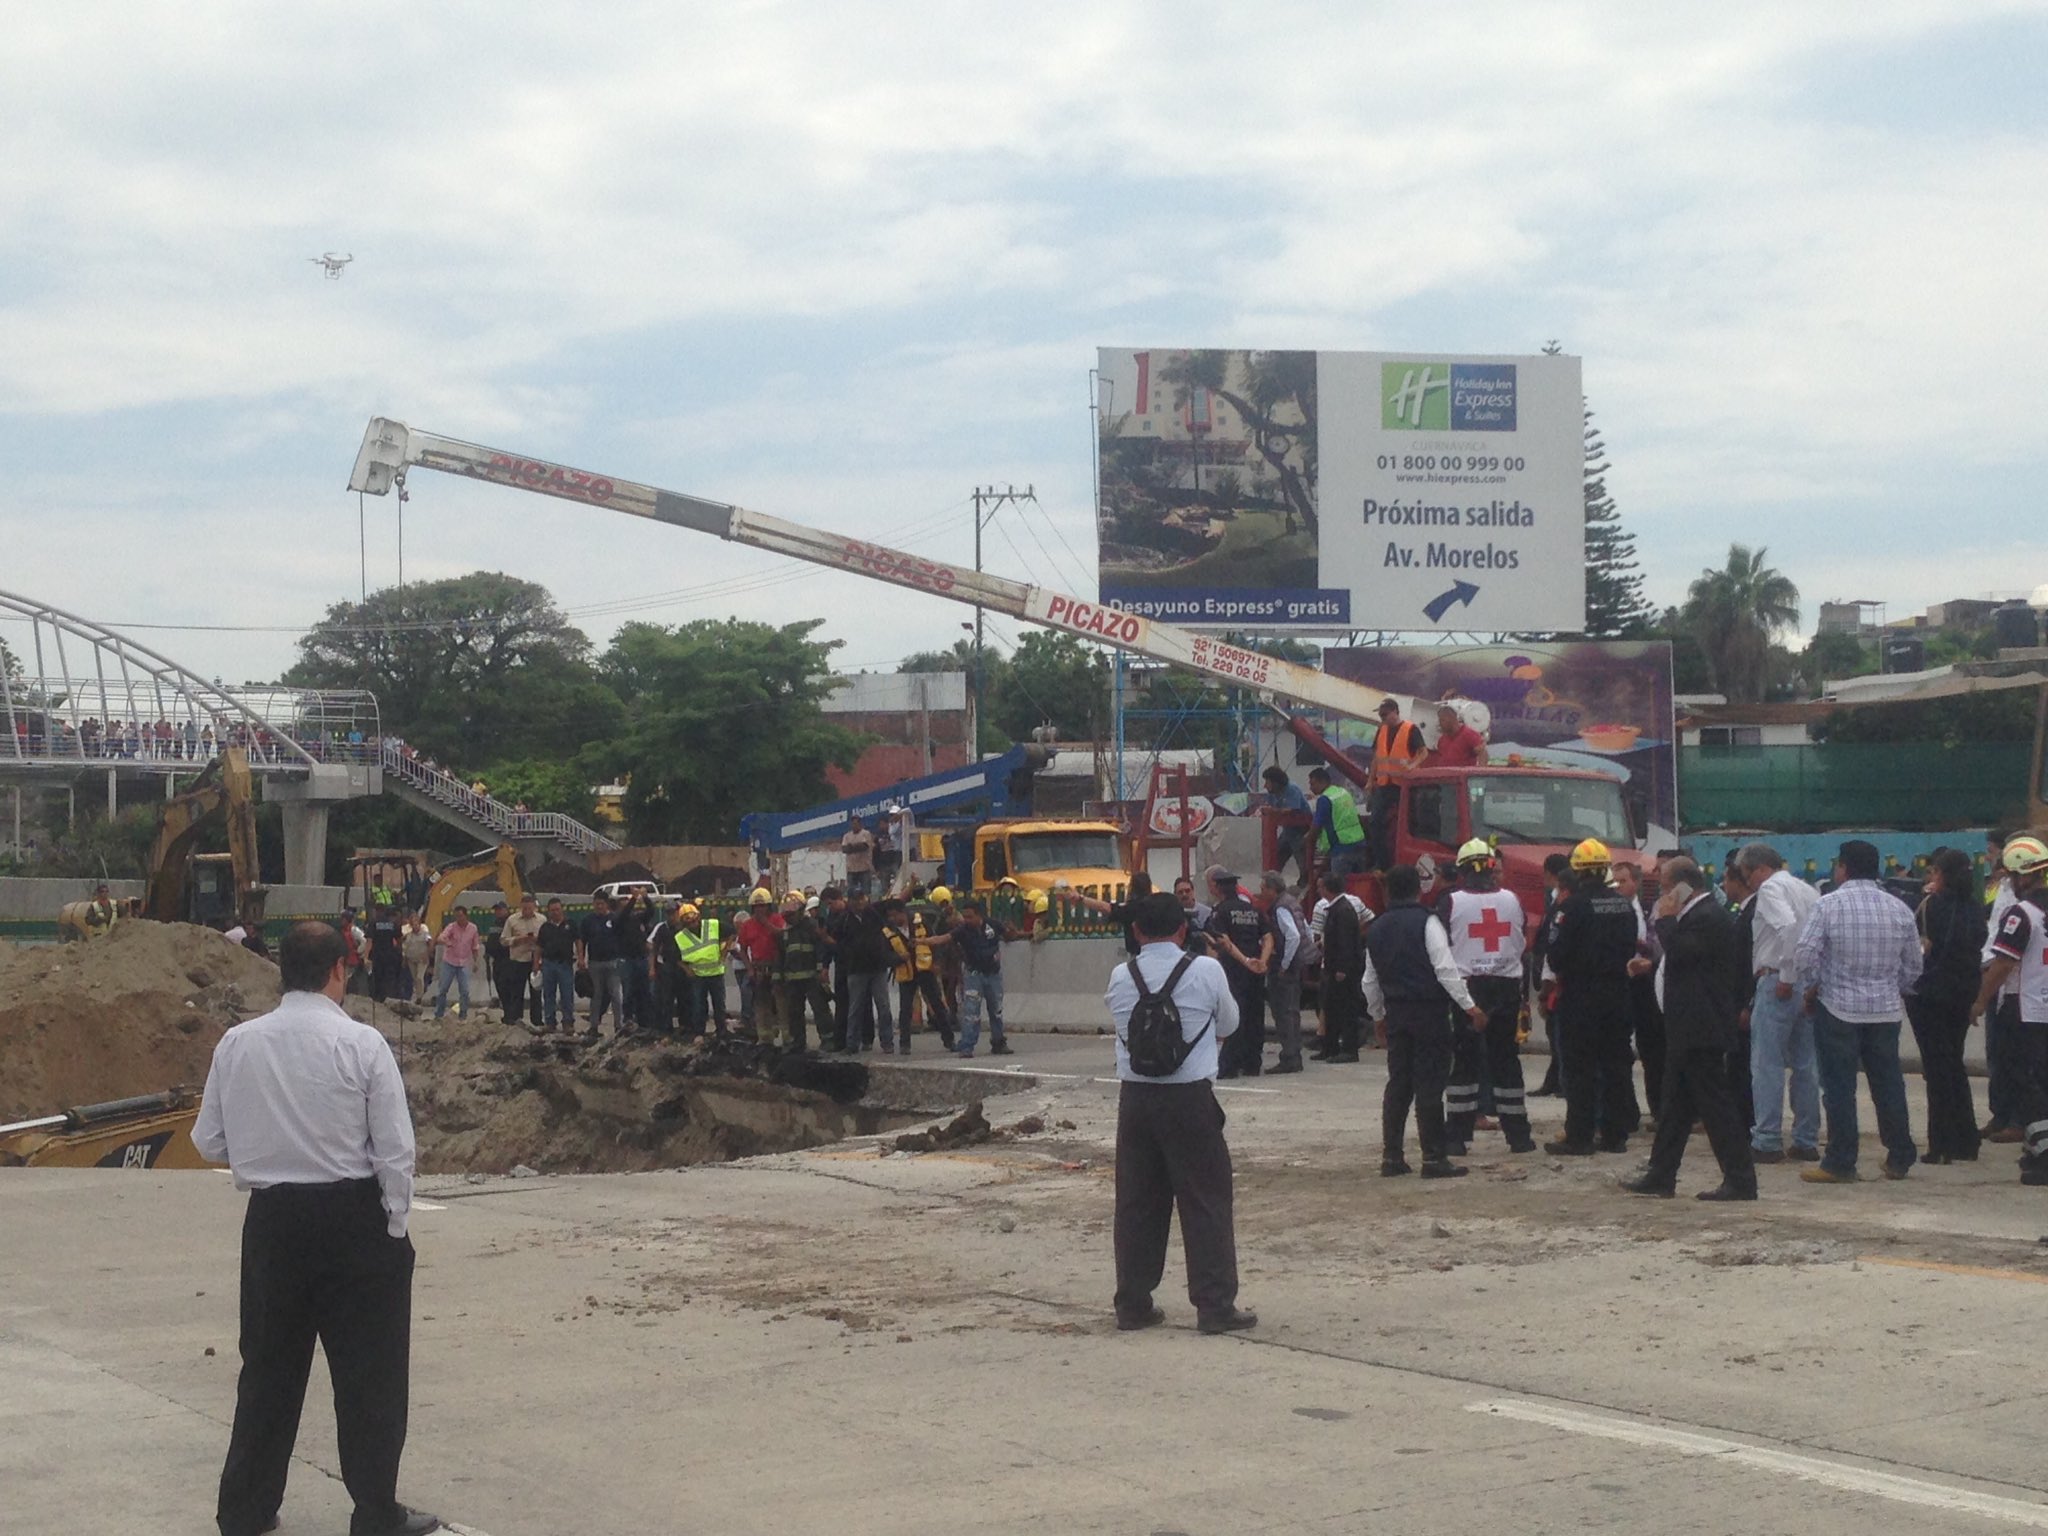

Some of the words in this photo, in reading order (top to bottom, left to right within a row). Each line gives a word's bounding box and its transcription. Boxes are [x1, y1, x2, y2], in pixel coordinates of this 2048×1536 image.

[1454, 378, 1494, 391] Holiday
[1496, 379, 1512, 389] Inn
[1455, 391, 1513, 409] Express
[1377, 455, 1397, 470] 01
[1403, 455, 1435, 470] 800
[1440, 456, 1462, 471] 00
[1466, 456, 1499, 471] 999
[1504, 457, 1525, 471] 00
[487, 454, 614, 501] PICAZO
[1396, 473, 1506, 486] www.hiexpress.com
[1363, 498, 1460, 526] Próxima
[1465, 500, 1534, 527] salida
[842, 543, 955, 590] PICAZO
[1384, 541, 1420, 568] Av.
[1426, 541, 1519, 570] Morelos
[1047, 595, 1140, 643] PICAZO
[1110, 598, 1200, 618] Desayuno
[1288, 600, 1340, 618] gratis
[1212, 658, 1233, 673] 229
[1236, 665, 1250, 679] 02
[1252, 670, 1267, 684] 05
[122, 1144, 152, 1169] CAT
